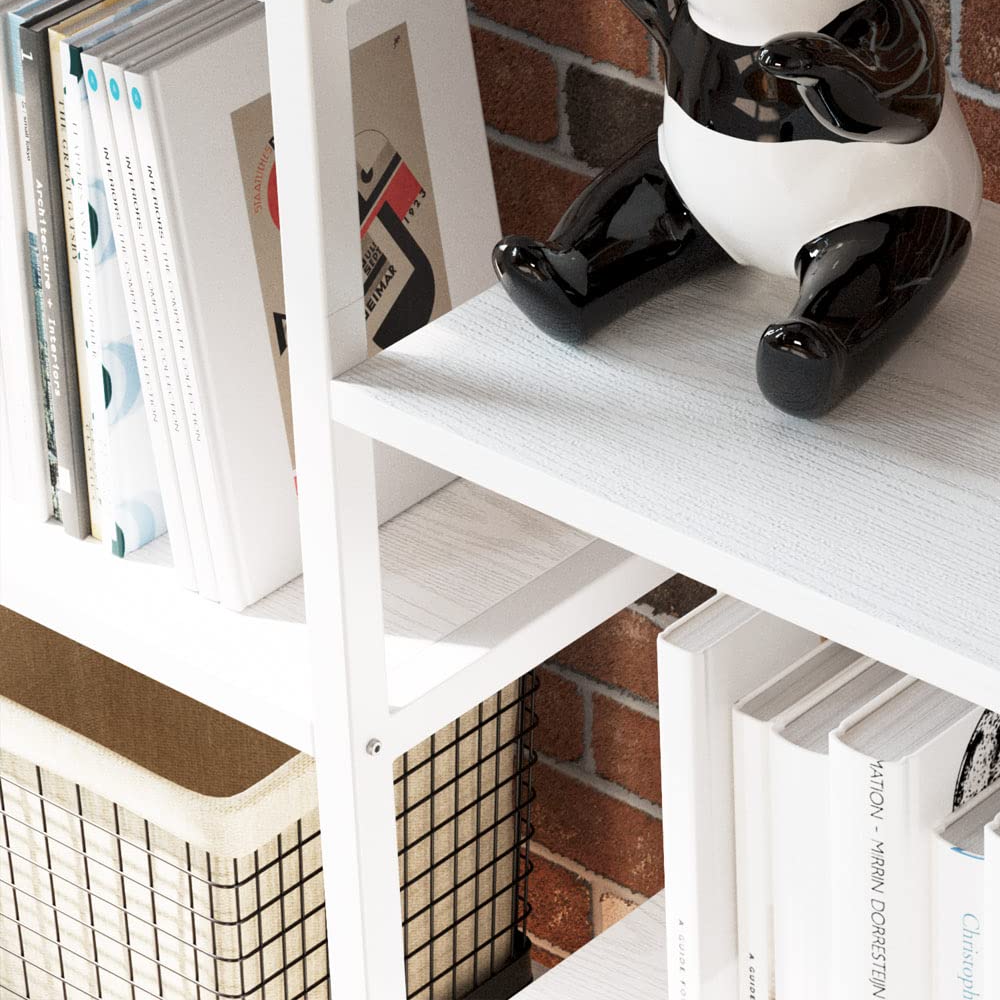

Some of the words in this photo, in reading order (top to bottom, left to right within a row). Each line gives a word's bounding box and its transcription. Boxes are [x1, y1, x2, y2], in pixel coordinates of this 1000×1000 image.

[58, 100, 67, 129] THE
[62, 138, 72, 192] GREAT
[103, 146, 120, 221] INTERIORS
[125, 155, 142, 231] INTERIORS
[67, 200, 78, 263] GATSBY
[147, 164, 164, 240] INTERIORS
[36, 178, 50, 290] Architecture
[48, 318, 60, 397] Interiors
[869, 837, 886, 895] MIRRIN
